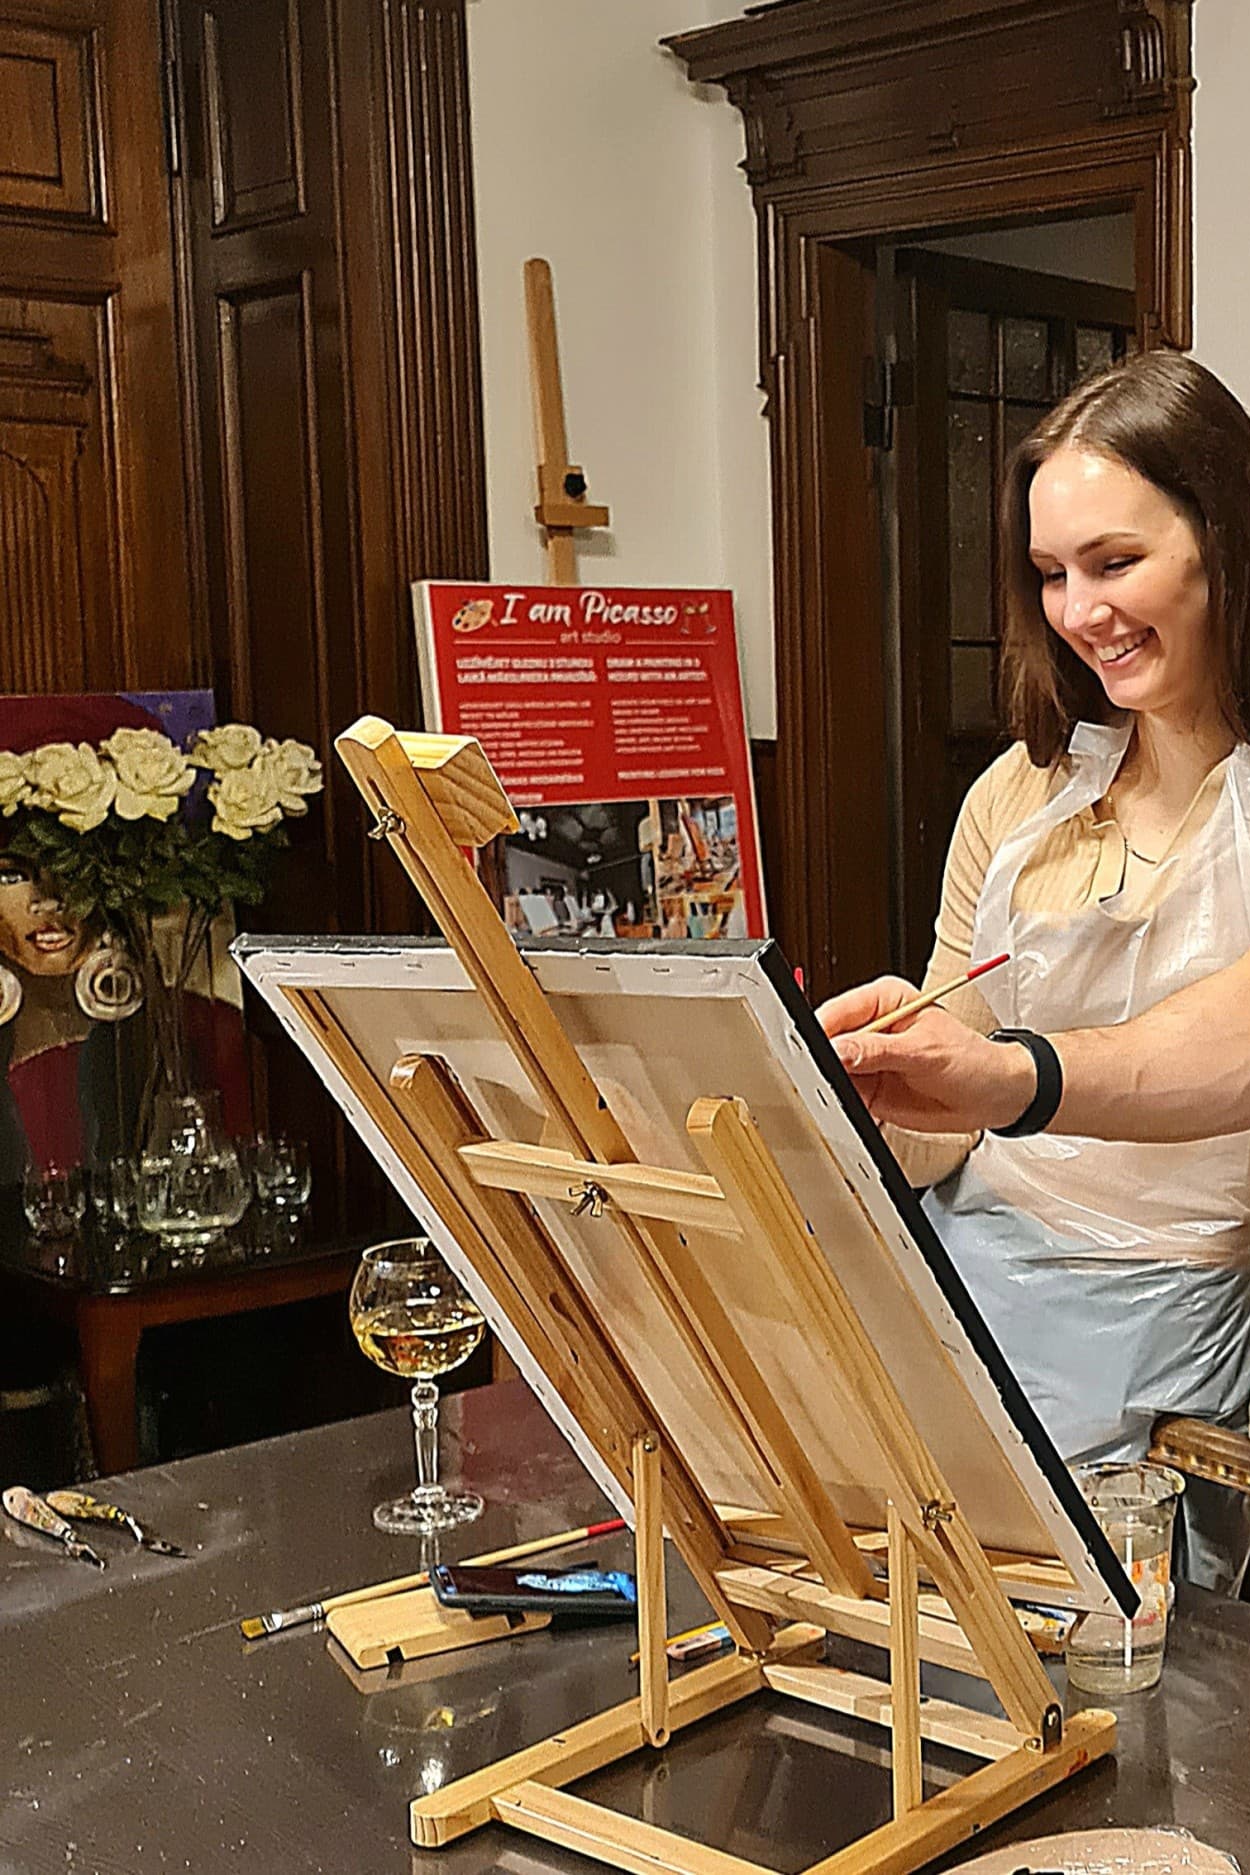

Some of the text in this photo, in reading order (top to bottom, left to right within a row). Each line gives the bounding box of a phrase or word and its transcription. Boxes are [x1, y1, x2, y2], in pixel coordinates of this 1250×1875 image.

[500, 591, 678, 627] I am Picasso
[560, 630, 622, 644] art studio
